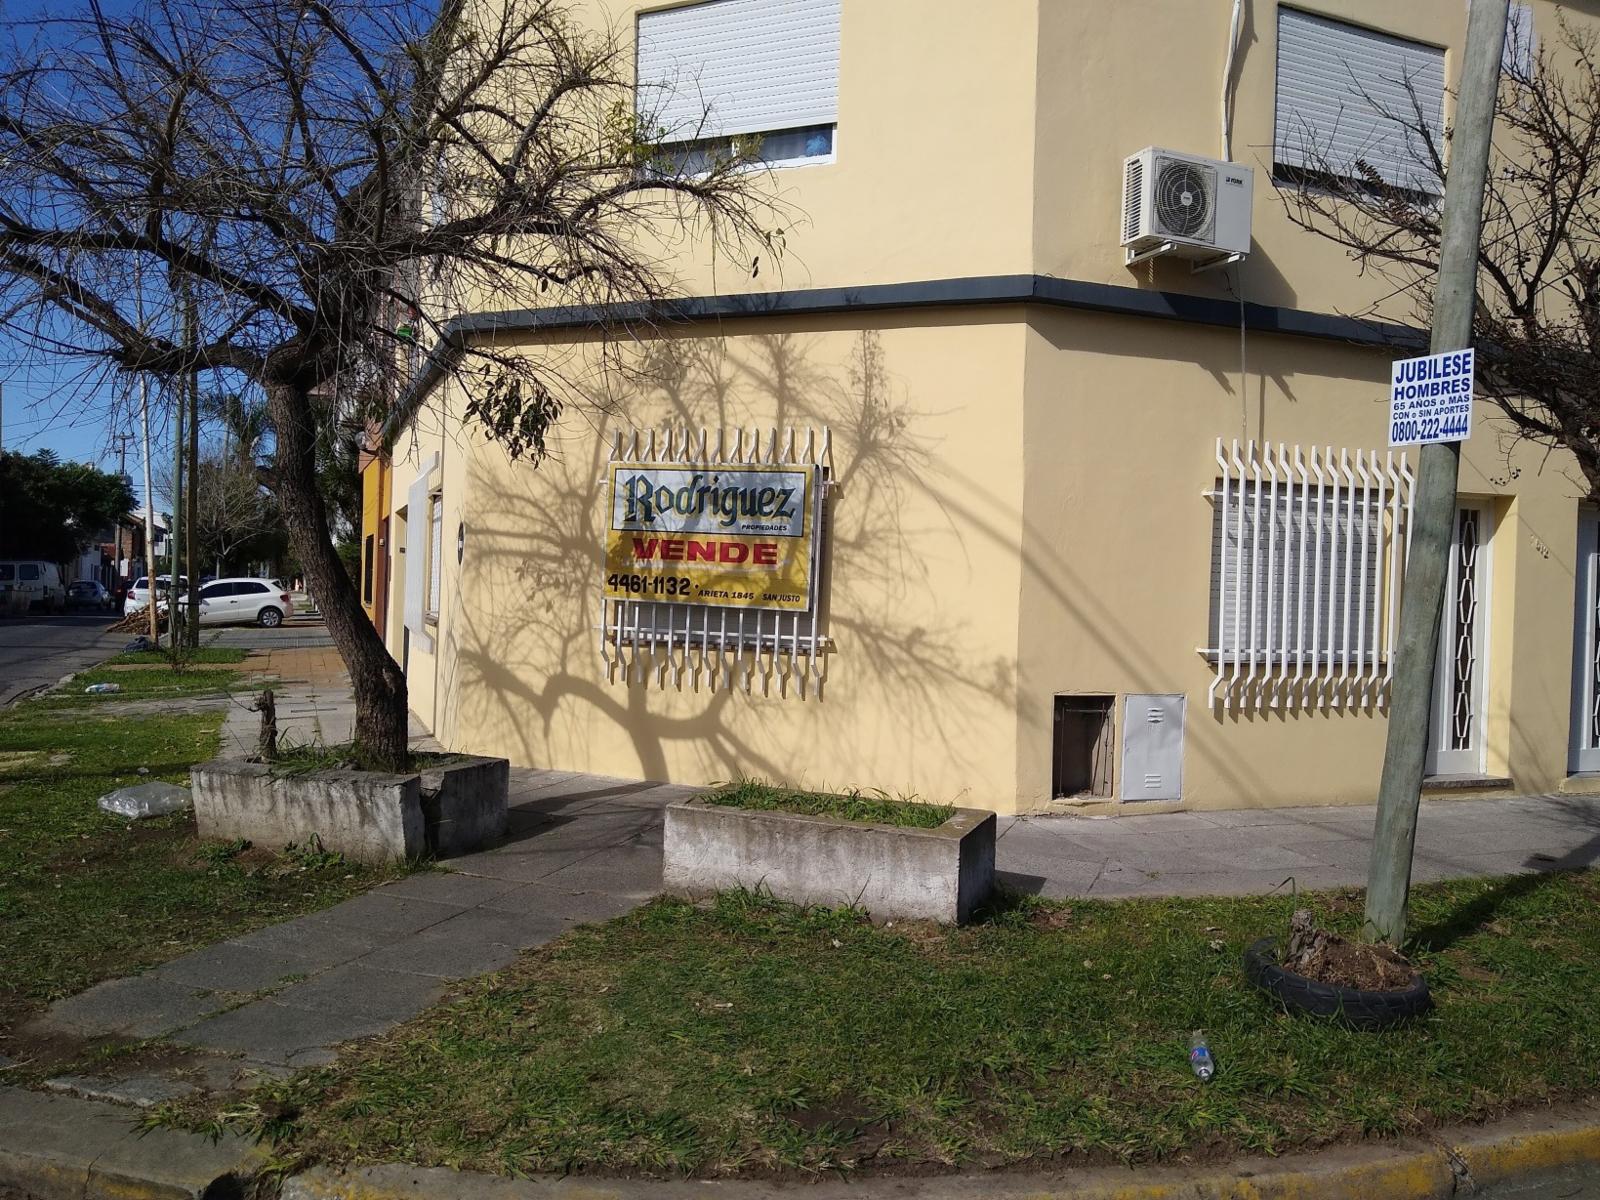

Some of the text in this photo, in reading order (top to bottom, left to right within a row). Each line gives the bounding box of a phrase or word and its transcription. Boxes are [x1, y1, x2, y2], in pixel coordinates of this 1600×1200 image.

[1395, 352, 1472, 384] JUBILESE
[1394, 377, 1471, 401] HOMBRES
[1392, 411, 1410, 420] CON
[1418, 408, 1432, 418] SIN
[1433, 404, 1470, 417] APORTES
[1393, 402, 1406, 411] 65
[1392, 414, 1468, 443] 0800-222-4444
[623, 473, 797, 527] Rodriguez
[741, 524, 788, 532] PROPIEDADES
[632, 538, 778, 565] VENDE
[607, 574, 691, 596] 4461-1132
[697, 589, 729, 599] ARIETA
[761, 593, 779, 602] SAN
[779, 594, 801, 603] JUSTO
